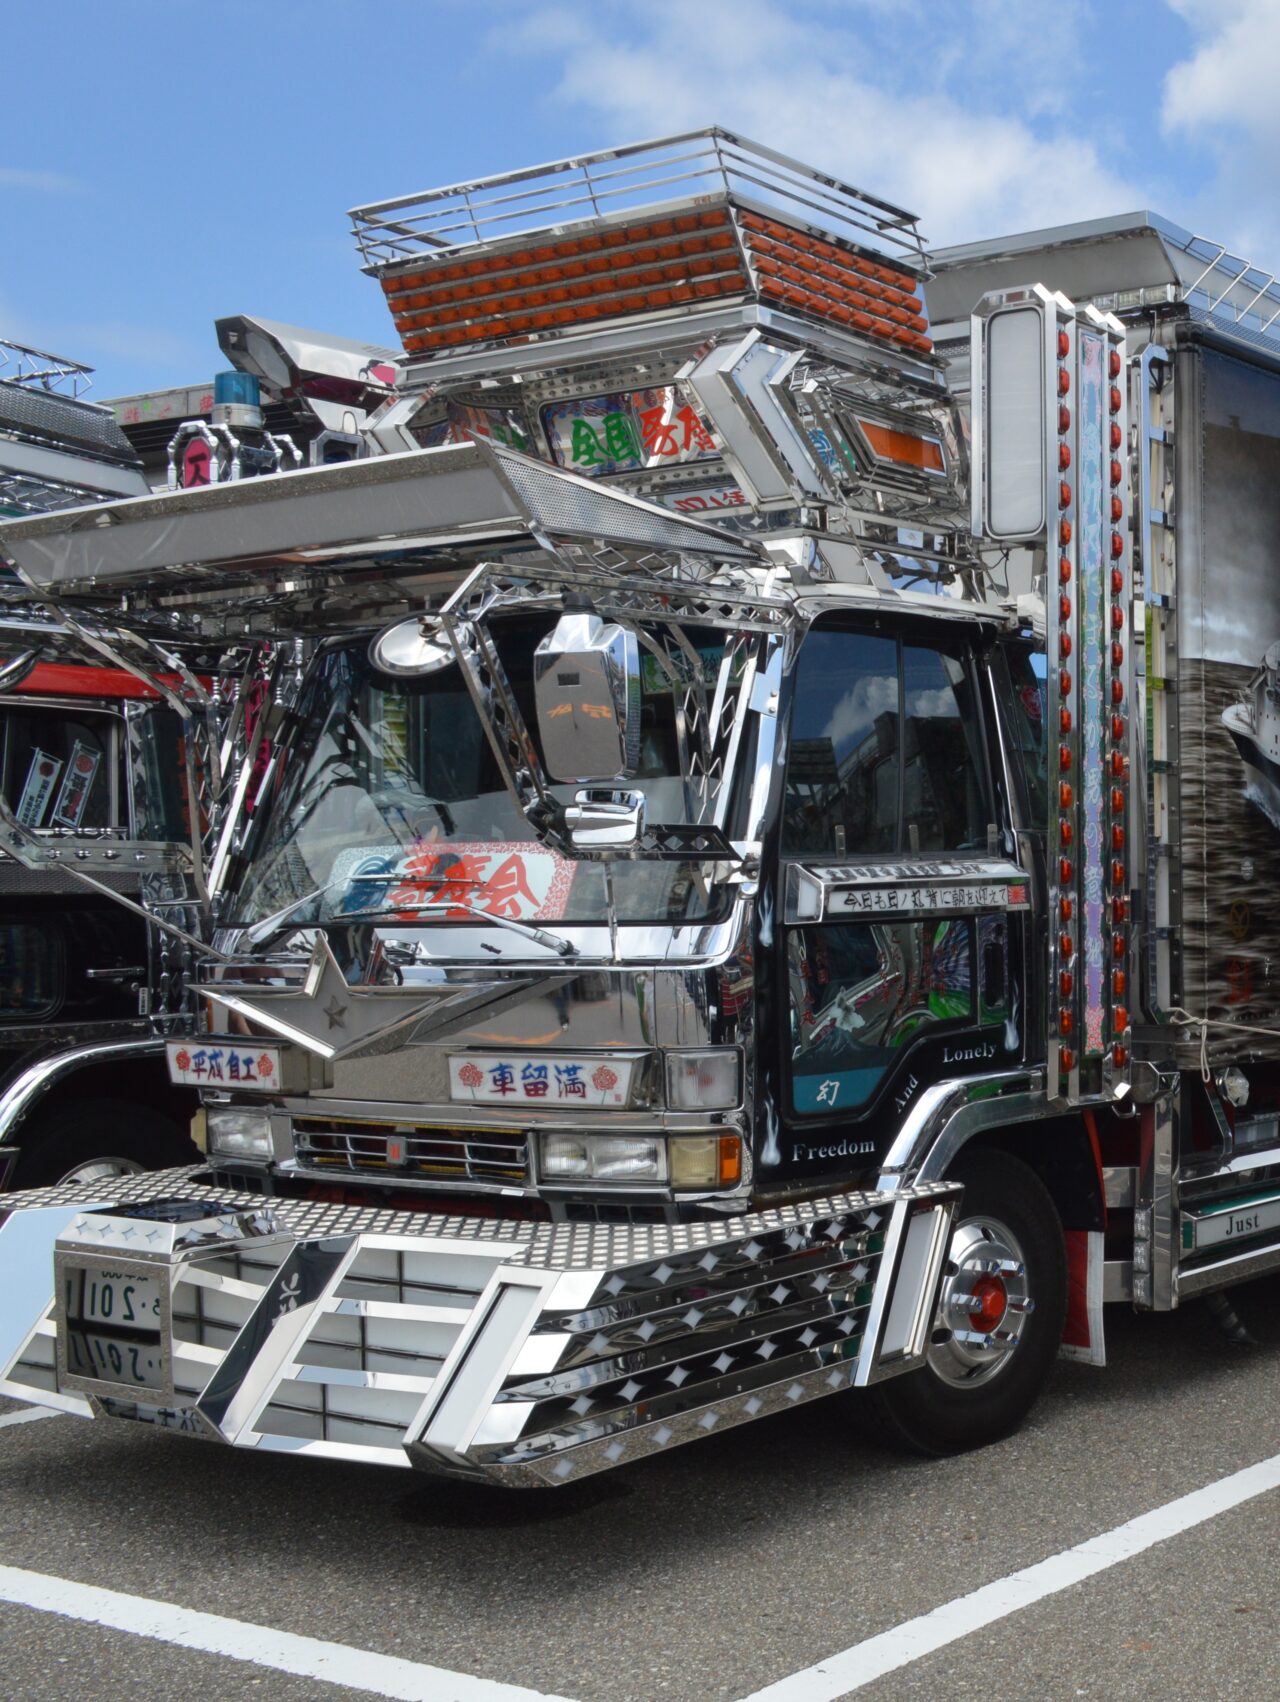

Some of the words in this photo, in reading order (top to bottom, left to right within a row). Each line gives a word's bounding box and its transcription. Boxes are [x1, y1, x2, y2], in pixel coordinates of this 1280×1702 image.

[191, 1050, 258, 1082] 平成自工
[487, 1062, 587, 1099] 車留満
[792, 1139, 876, 1162] Freedom
[897, 1073, 919, 1113] And
[943, 1043, 998, 1064] Lonely
[816, 1080, 840, 1106] 幻
[1226, 1212, 1260, 1236] Just
